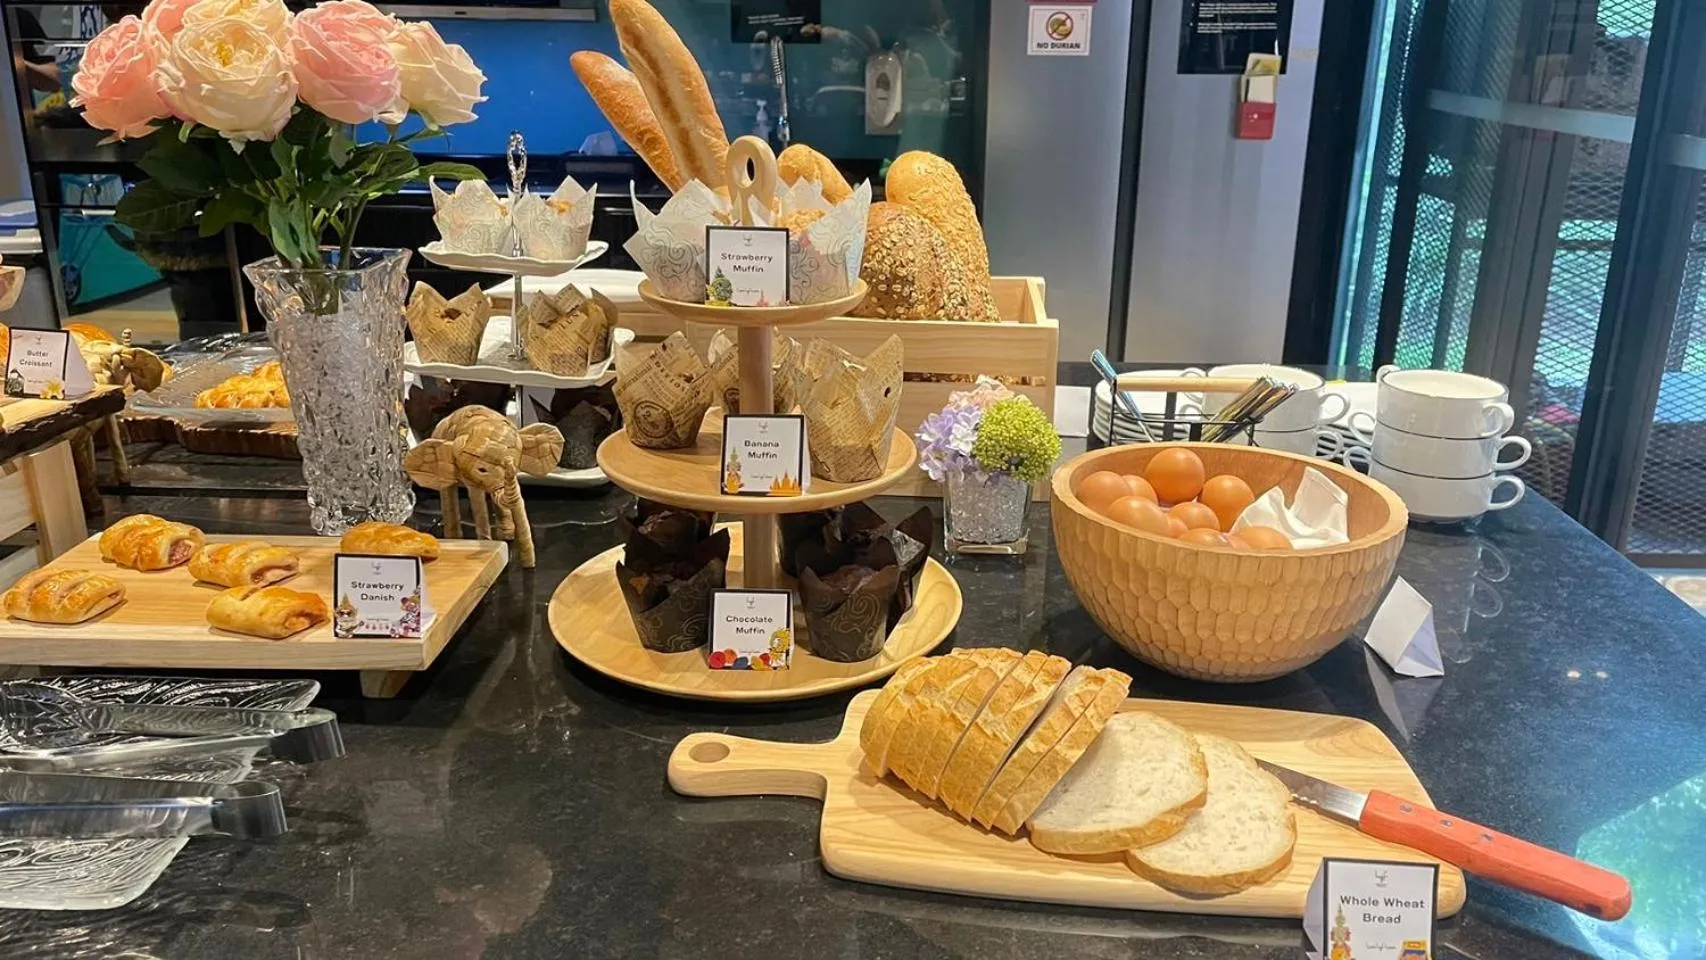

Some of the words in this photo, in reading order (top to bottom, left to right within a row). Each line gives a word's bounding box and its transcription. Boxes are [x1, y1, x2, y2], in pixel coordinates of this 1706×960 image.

[720, 252, 774, 264] Strawberry
[732, 264, 765, 273] Muffin
[26, 349, 49, 357] Butter
[19, 359, 53, 368] Croissant
[744, 439, 780, 448] Banana
[747, 451, 778, 459] Muffin
[350, 580, 405, 591] Strawberry
[360, 593, 395, 601] Danish
[725, 614, 773, 623] Chocolate
[735, 627, 766, 635] Muffin
[1339, 894, 1380, 907] Whole
[1383, 896, 1425, 909] Wheat
[1362, 912, 1402, 925] Bread
